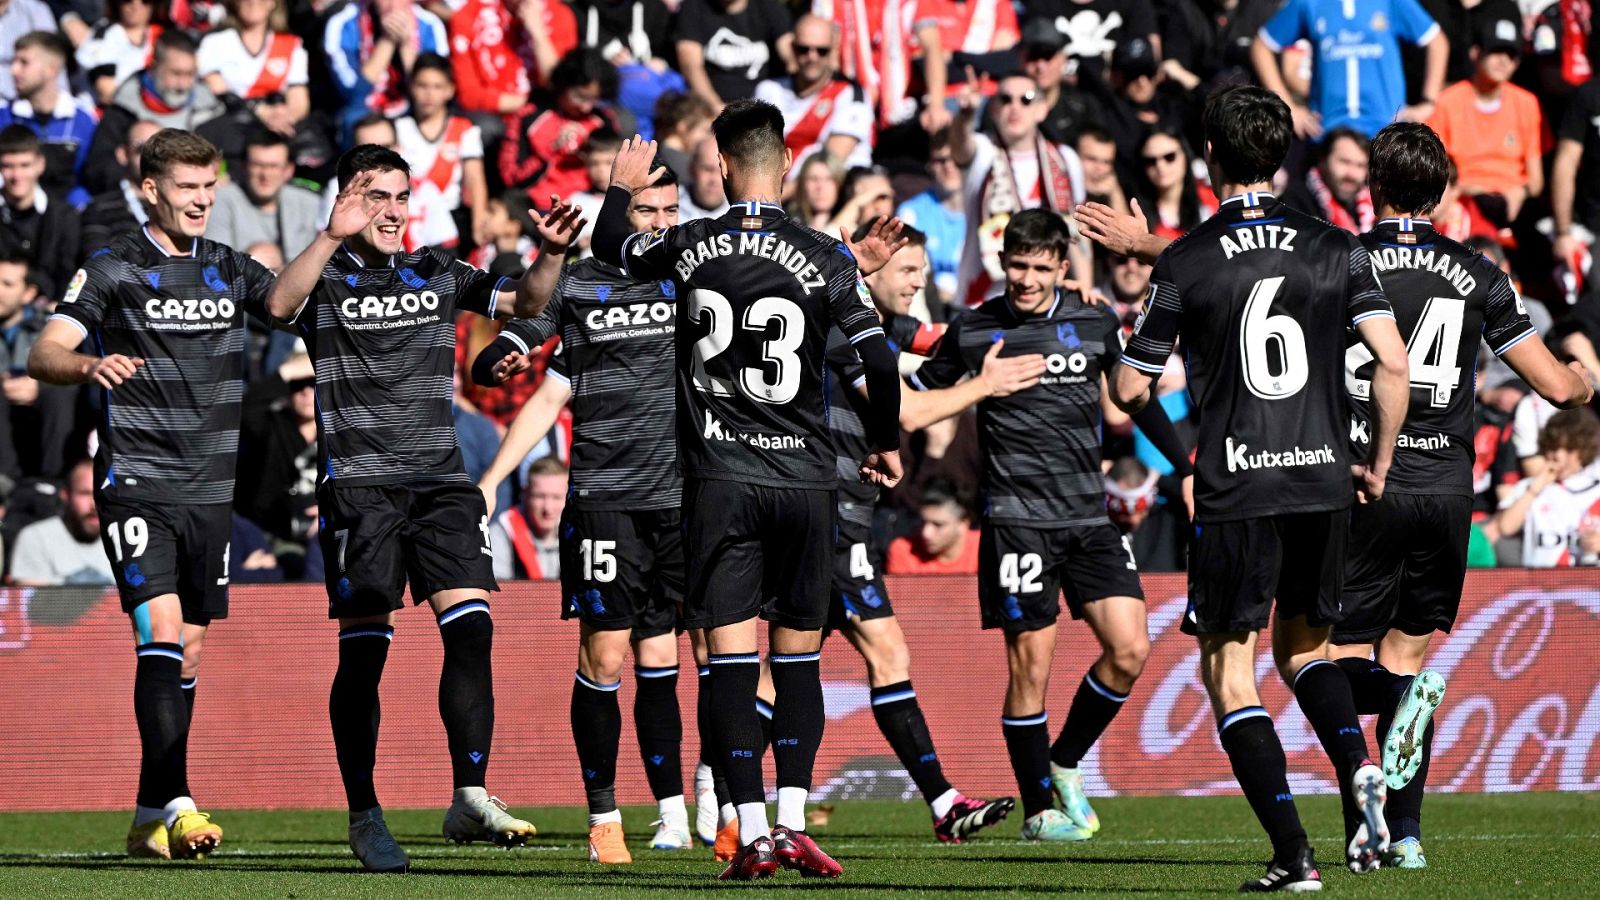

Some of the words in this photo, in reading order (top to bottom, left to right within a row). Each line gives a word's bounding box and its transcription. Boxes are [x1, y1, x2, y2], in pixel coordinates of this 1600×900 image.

[674, 233, 733, 282] BRAIS
[738, 232, 826, 295] MÉNDEZ
[1219, 225, 1297, 260] ARITZ
[1368, 247, 1476, 297] NORMAND
[145, 298, 235, 320] CAZOO
[341, 290, 439, 318] CAZOO
[586, 302, 677, 330] CAZO
[687, 288, 805, 405] 23
[1240, 275, 1309, 400] 6
[703, 408, 806, 450] Kuxabank
[1225, 436, 1336, 473] Kutxabank
[107, 516, 149, 562] 19
[334, 528, 349, 572] 7
[579, 538, 617, 582] 15
[850, 542, 875, 580] 4
[999, 552, 1044, 594] 42
